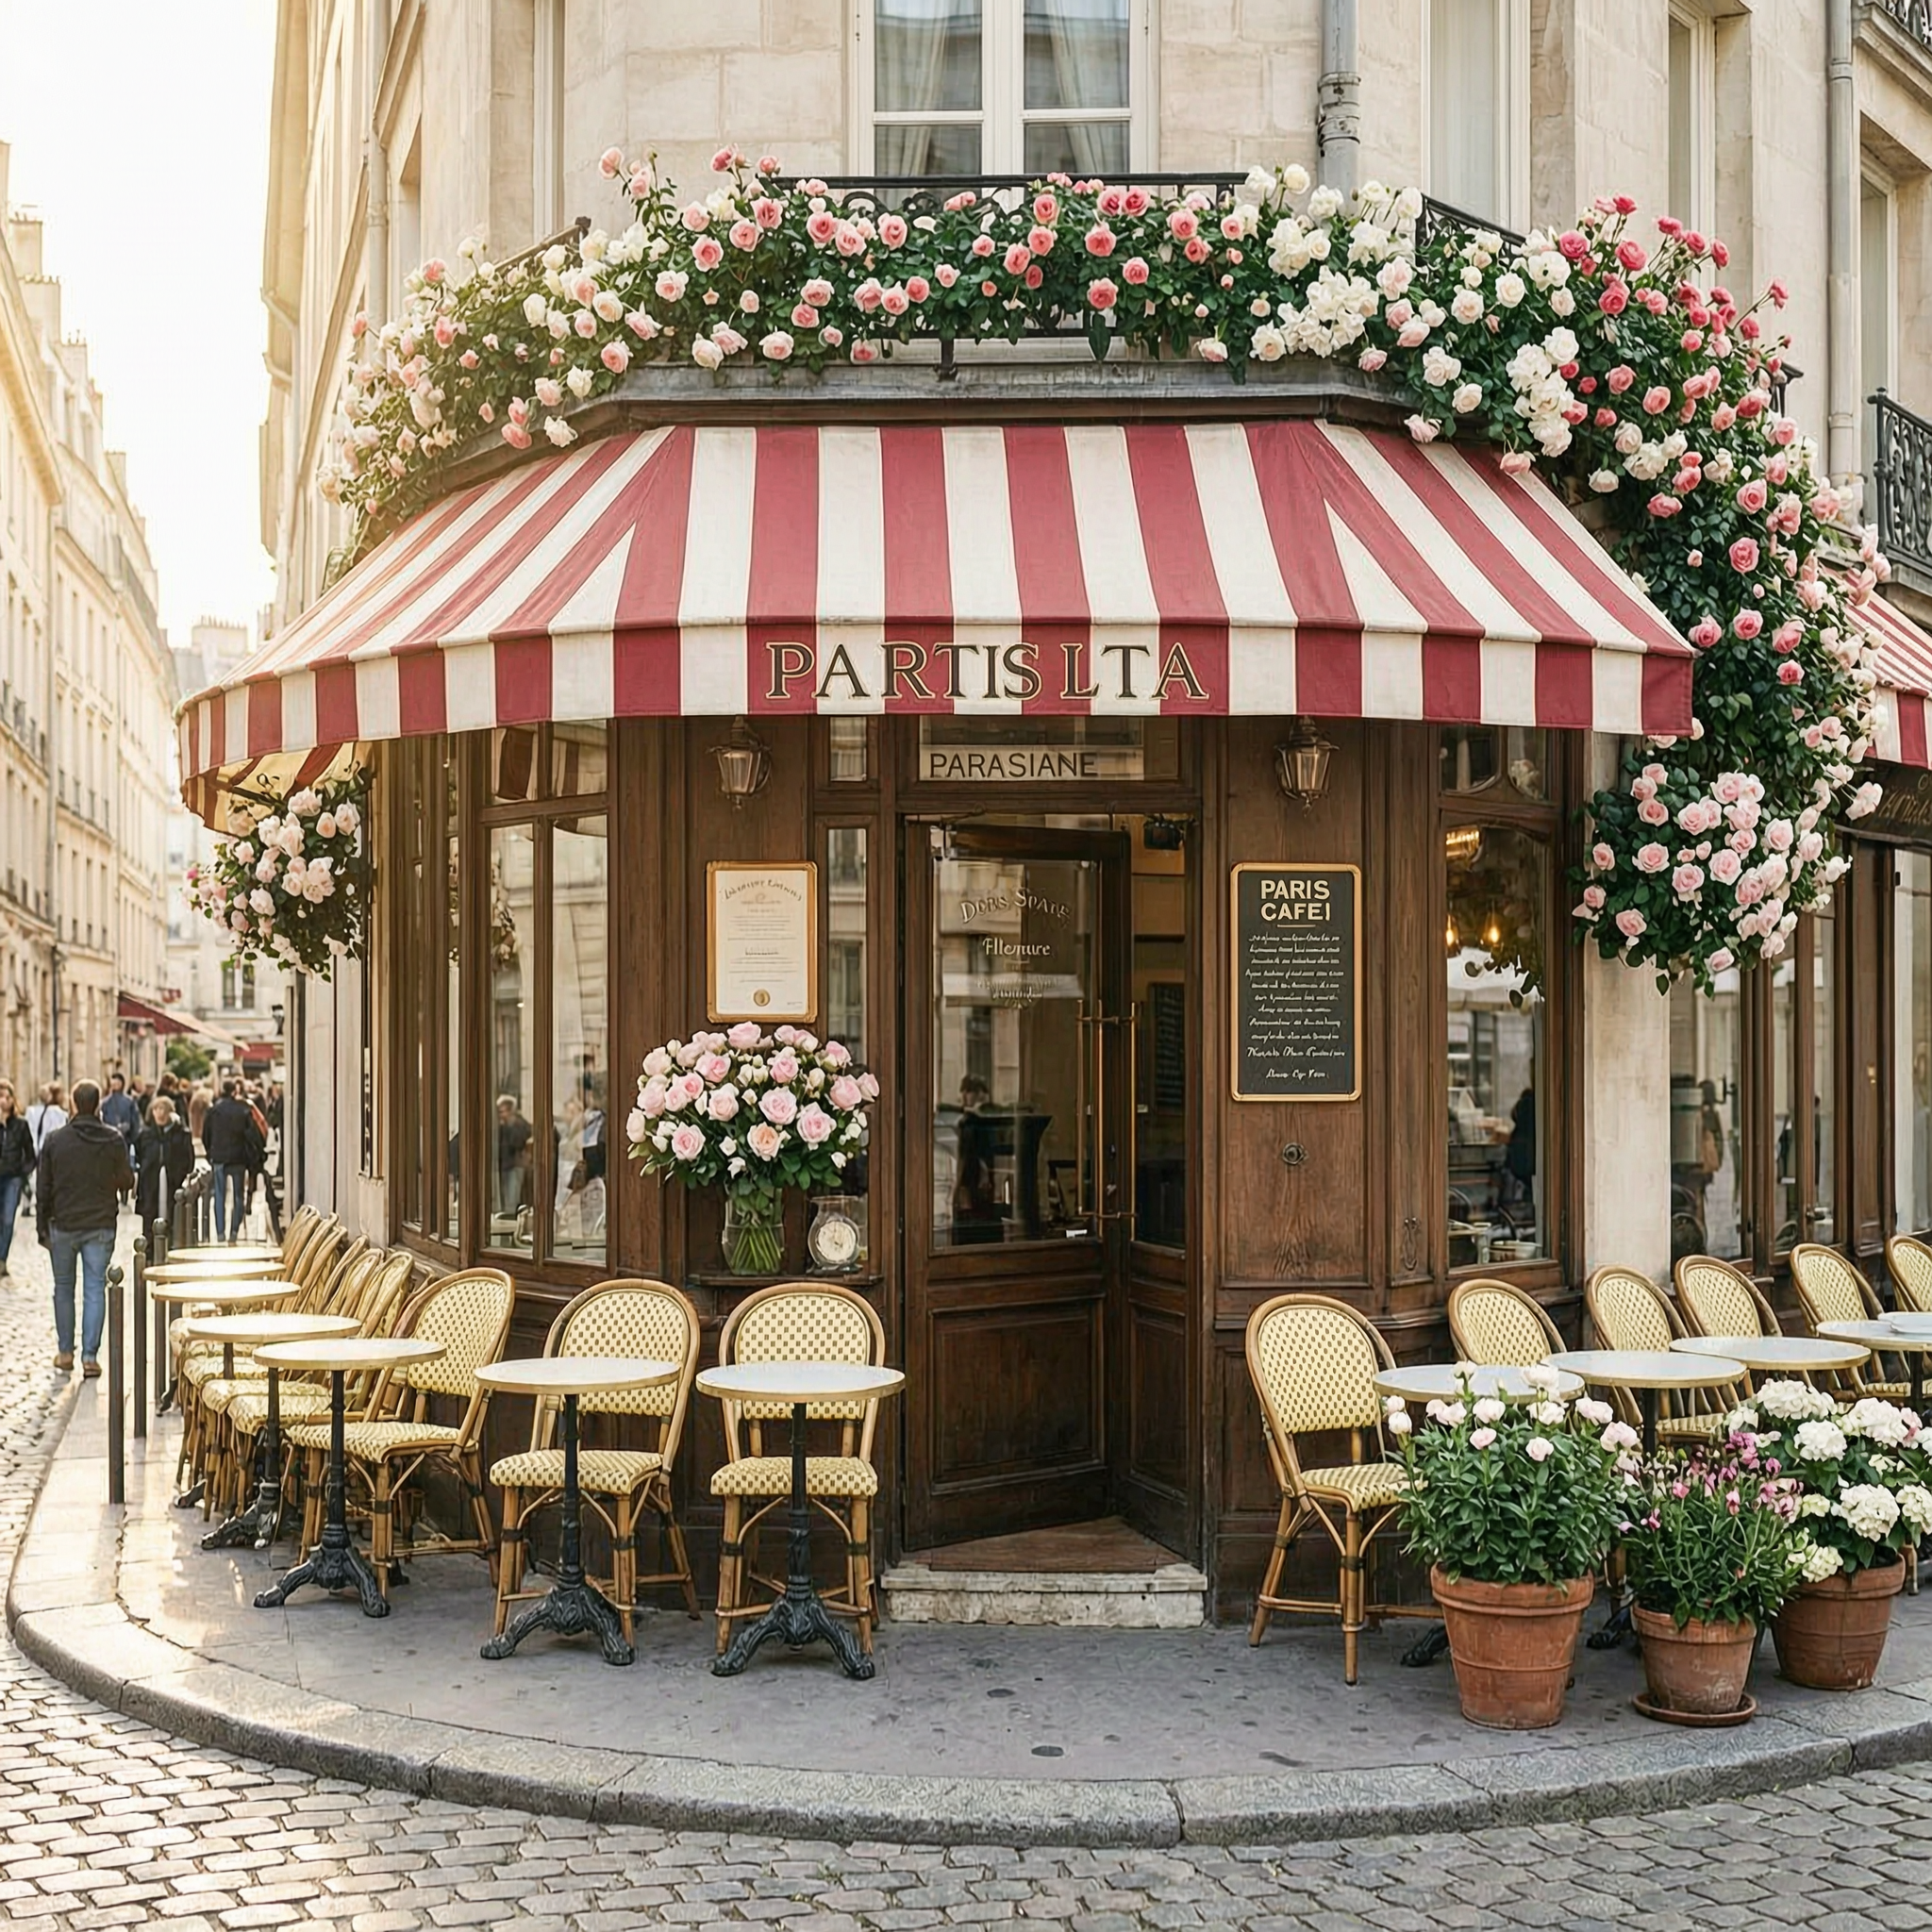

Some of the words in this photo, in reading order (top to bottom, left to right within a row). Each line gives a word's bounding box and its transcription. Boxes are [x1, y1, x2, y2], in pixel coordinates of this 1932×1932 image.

[1059, 641, 1211, 700] LTA
[929, 752, 1098, 778] PARASIANE
[1260, 879, 1331, 900] PARIS
